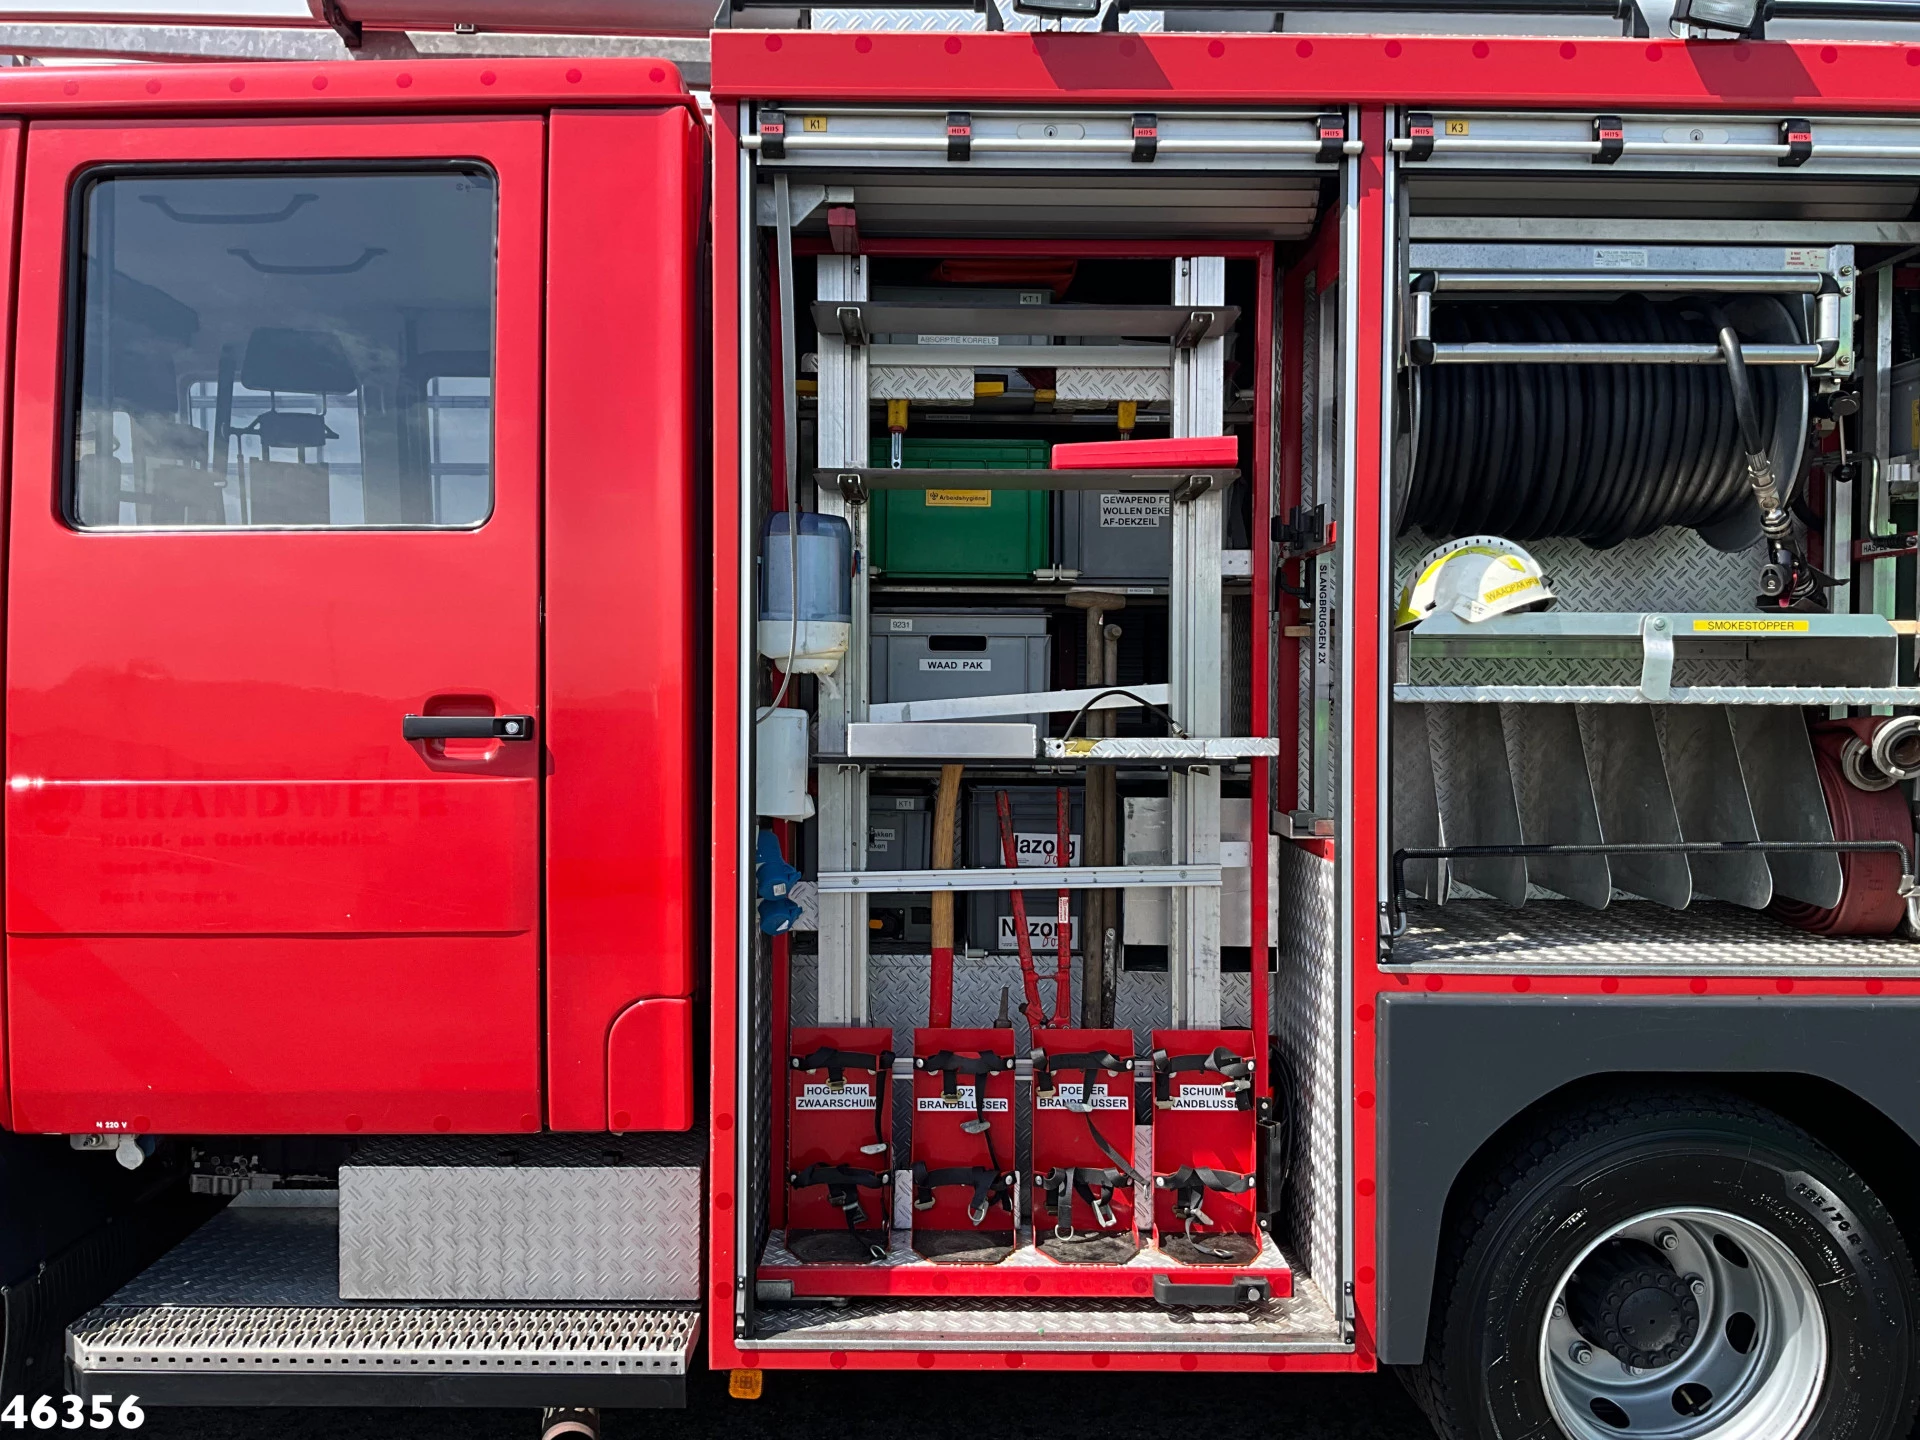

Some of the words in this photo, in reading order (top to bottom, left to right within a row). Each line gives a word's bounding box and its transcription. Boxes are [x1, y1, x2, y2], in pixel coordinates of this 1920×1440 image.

[810, 120, 820, 129] K1
[1452, 123, 1464, 133] K3
[1022, 295, 1032, 303] KT
[1103, 496, 1156, 504] GEWAPEND
[1318, 564, 1327, 649] SLANGBRUGGEN
[1707, 621, 1795, 630] SMOKESTOPPER
[1318, 652, 1326, 664] 2X
[927, 661, 958, 669] WAAD
[962, 661, 983, 669] PAK
[1061, 1086, 1105, 1095] POEER
[1182, 1087, 1224, 1096] SCHUIM
